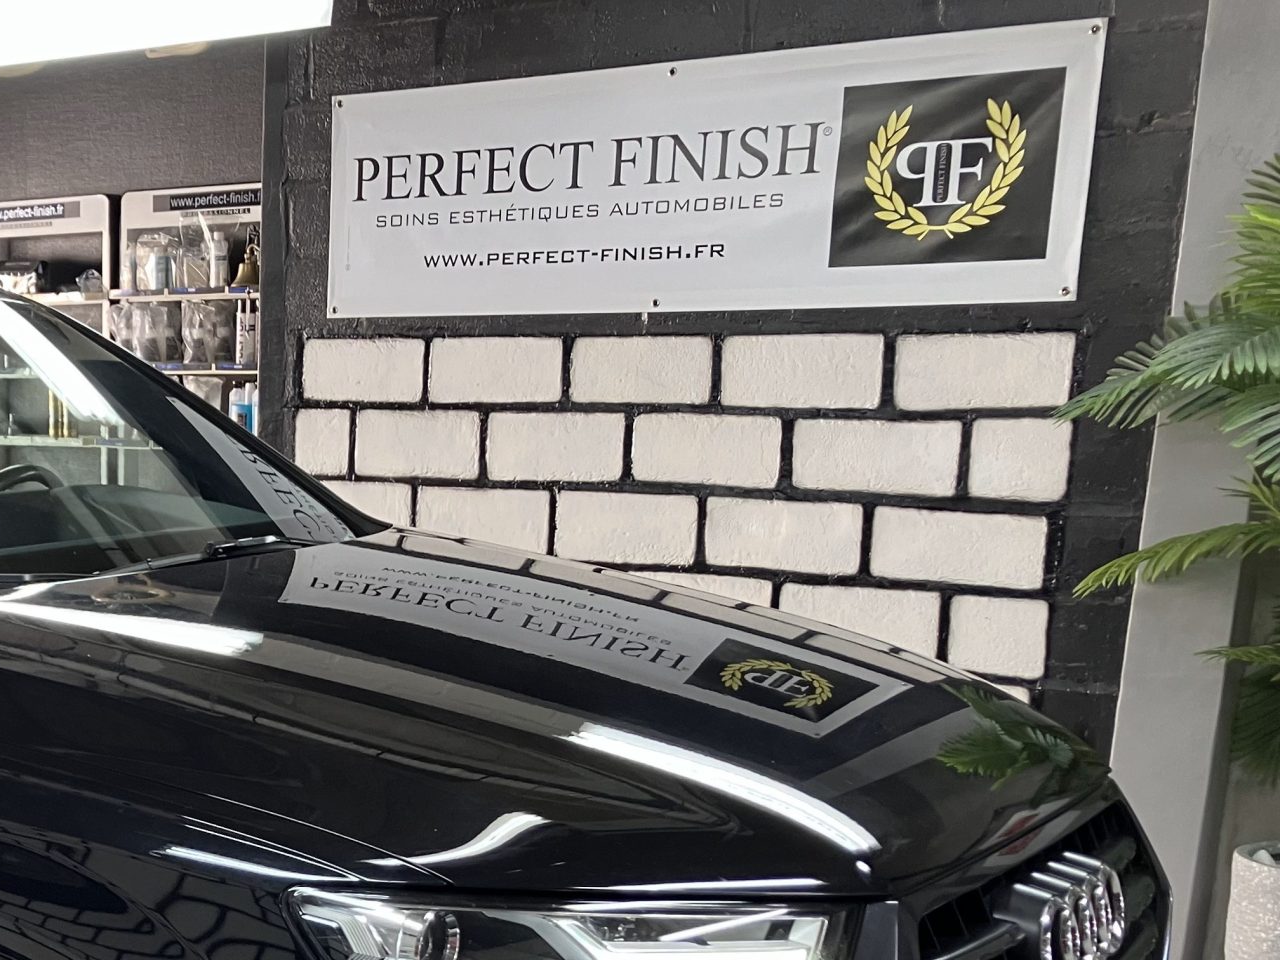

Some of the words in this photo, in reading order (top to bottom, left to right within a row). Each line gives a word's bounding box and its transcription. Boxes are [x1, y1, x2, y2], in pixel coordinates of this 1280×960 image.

[352, 140, 594, 202] PERFECT
[170, 191, 260, 208] www.perfect-finish.f
[375, 212, 439, 228] SOINS
[449, 203, 600, 224] ESTHÉTIQUES
[609, 193, 785, 217] AUTOMOBILES
[423, 243, 726, 269] WWW.PERFECT-FINISH.FR
